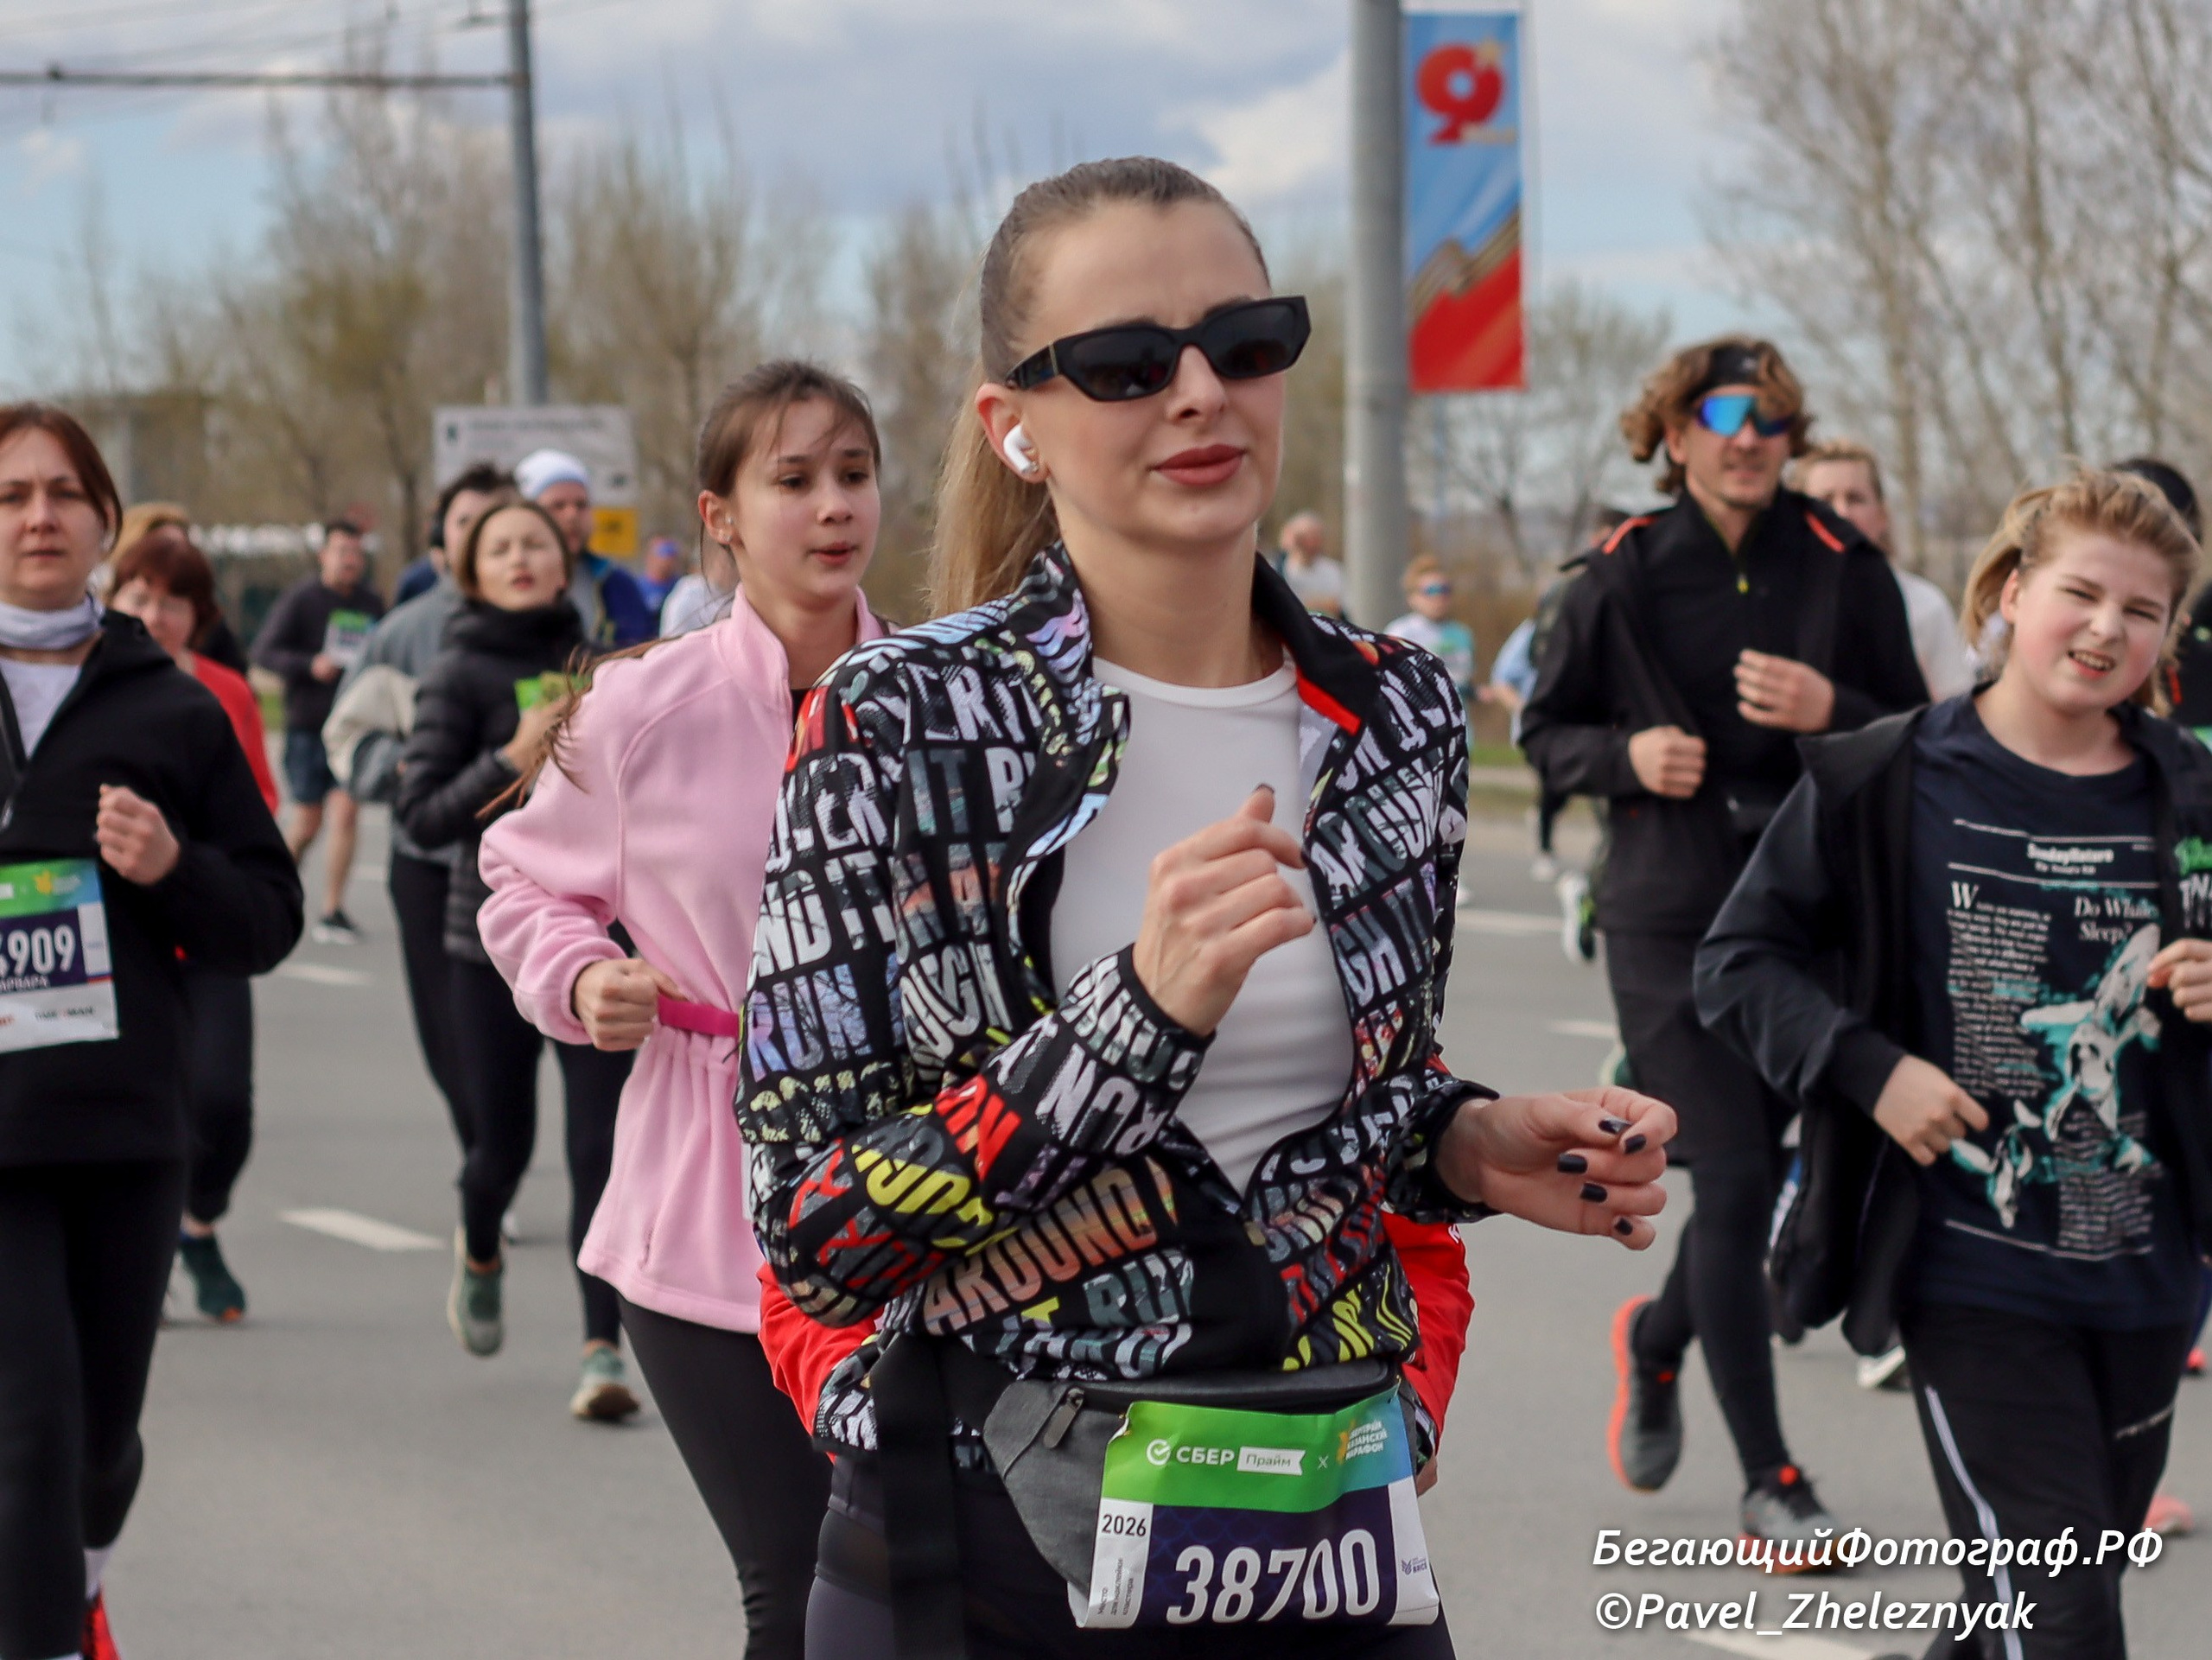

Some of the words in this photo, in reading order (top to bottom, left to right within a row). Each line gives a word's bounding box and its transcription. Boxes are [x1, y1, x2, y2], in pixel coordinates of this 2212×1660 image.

[914, 1167, 1159, 1336] AROUND
[1175, 1446, 1236, 1466] СБЕР
[1245, 1453, 1292, 1468] Прайм
[1101, 1513, 1147, 1537] 2026
[1166, 1528, 1381, 1625] 38700
